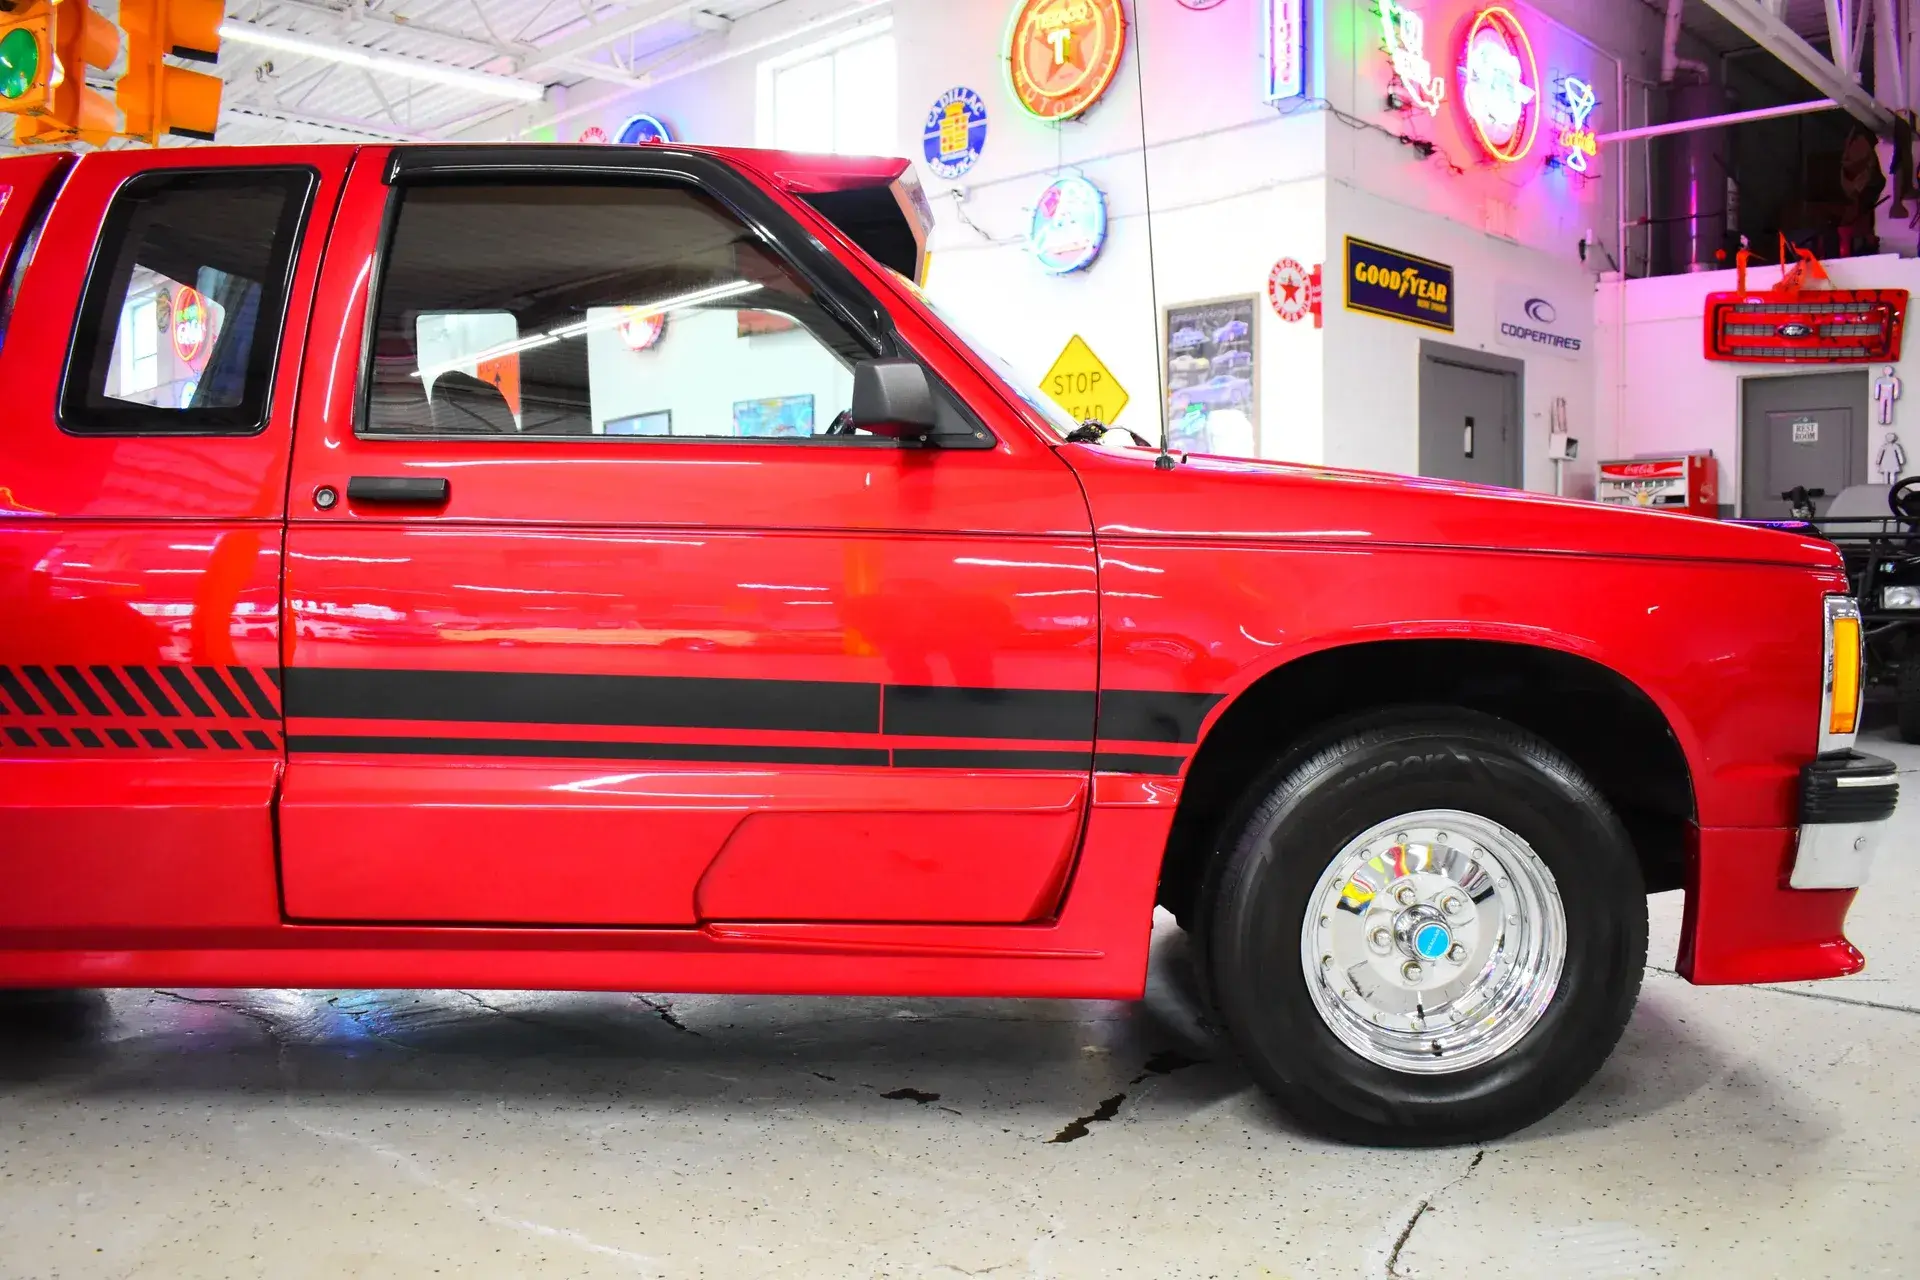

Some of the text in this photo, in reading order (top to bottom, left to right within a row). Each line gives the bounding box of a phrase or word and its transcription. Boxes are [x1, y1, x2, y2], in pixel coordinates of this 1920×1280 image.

[927, 87, 985, 128] CADILLAC
[1355, 261, 1448, 303] GOODYEAR
[1053, 371, 1102, 396] STOP
[1068, 404, 1104, 421] EAD
[1795, 431, 1816, 441] ROOM
[1796, 424, 1816, 432] REST
